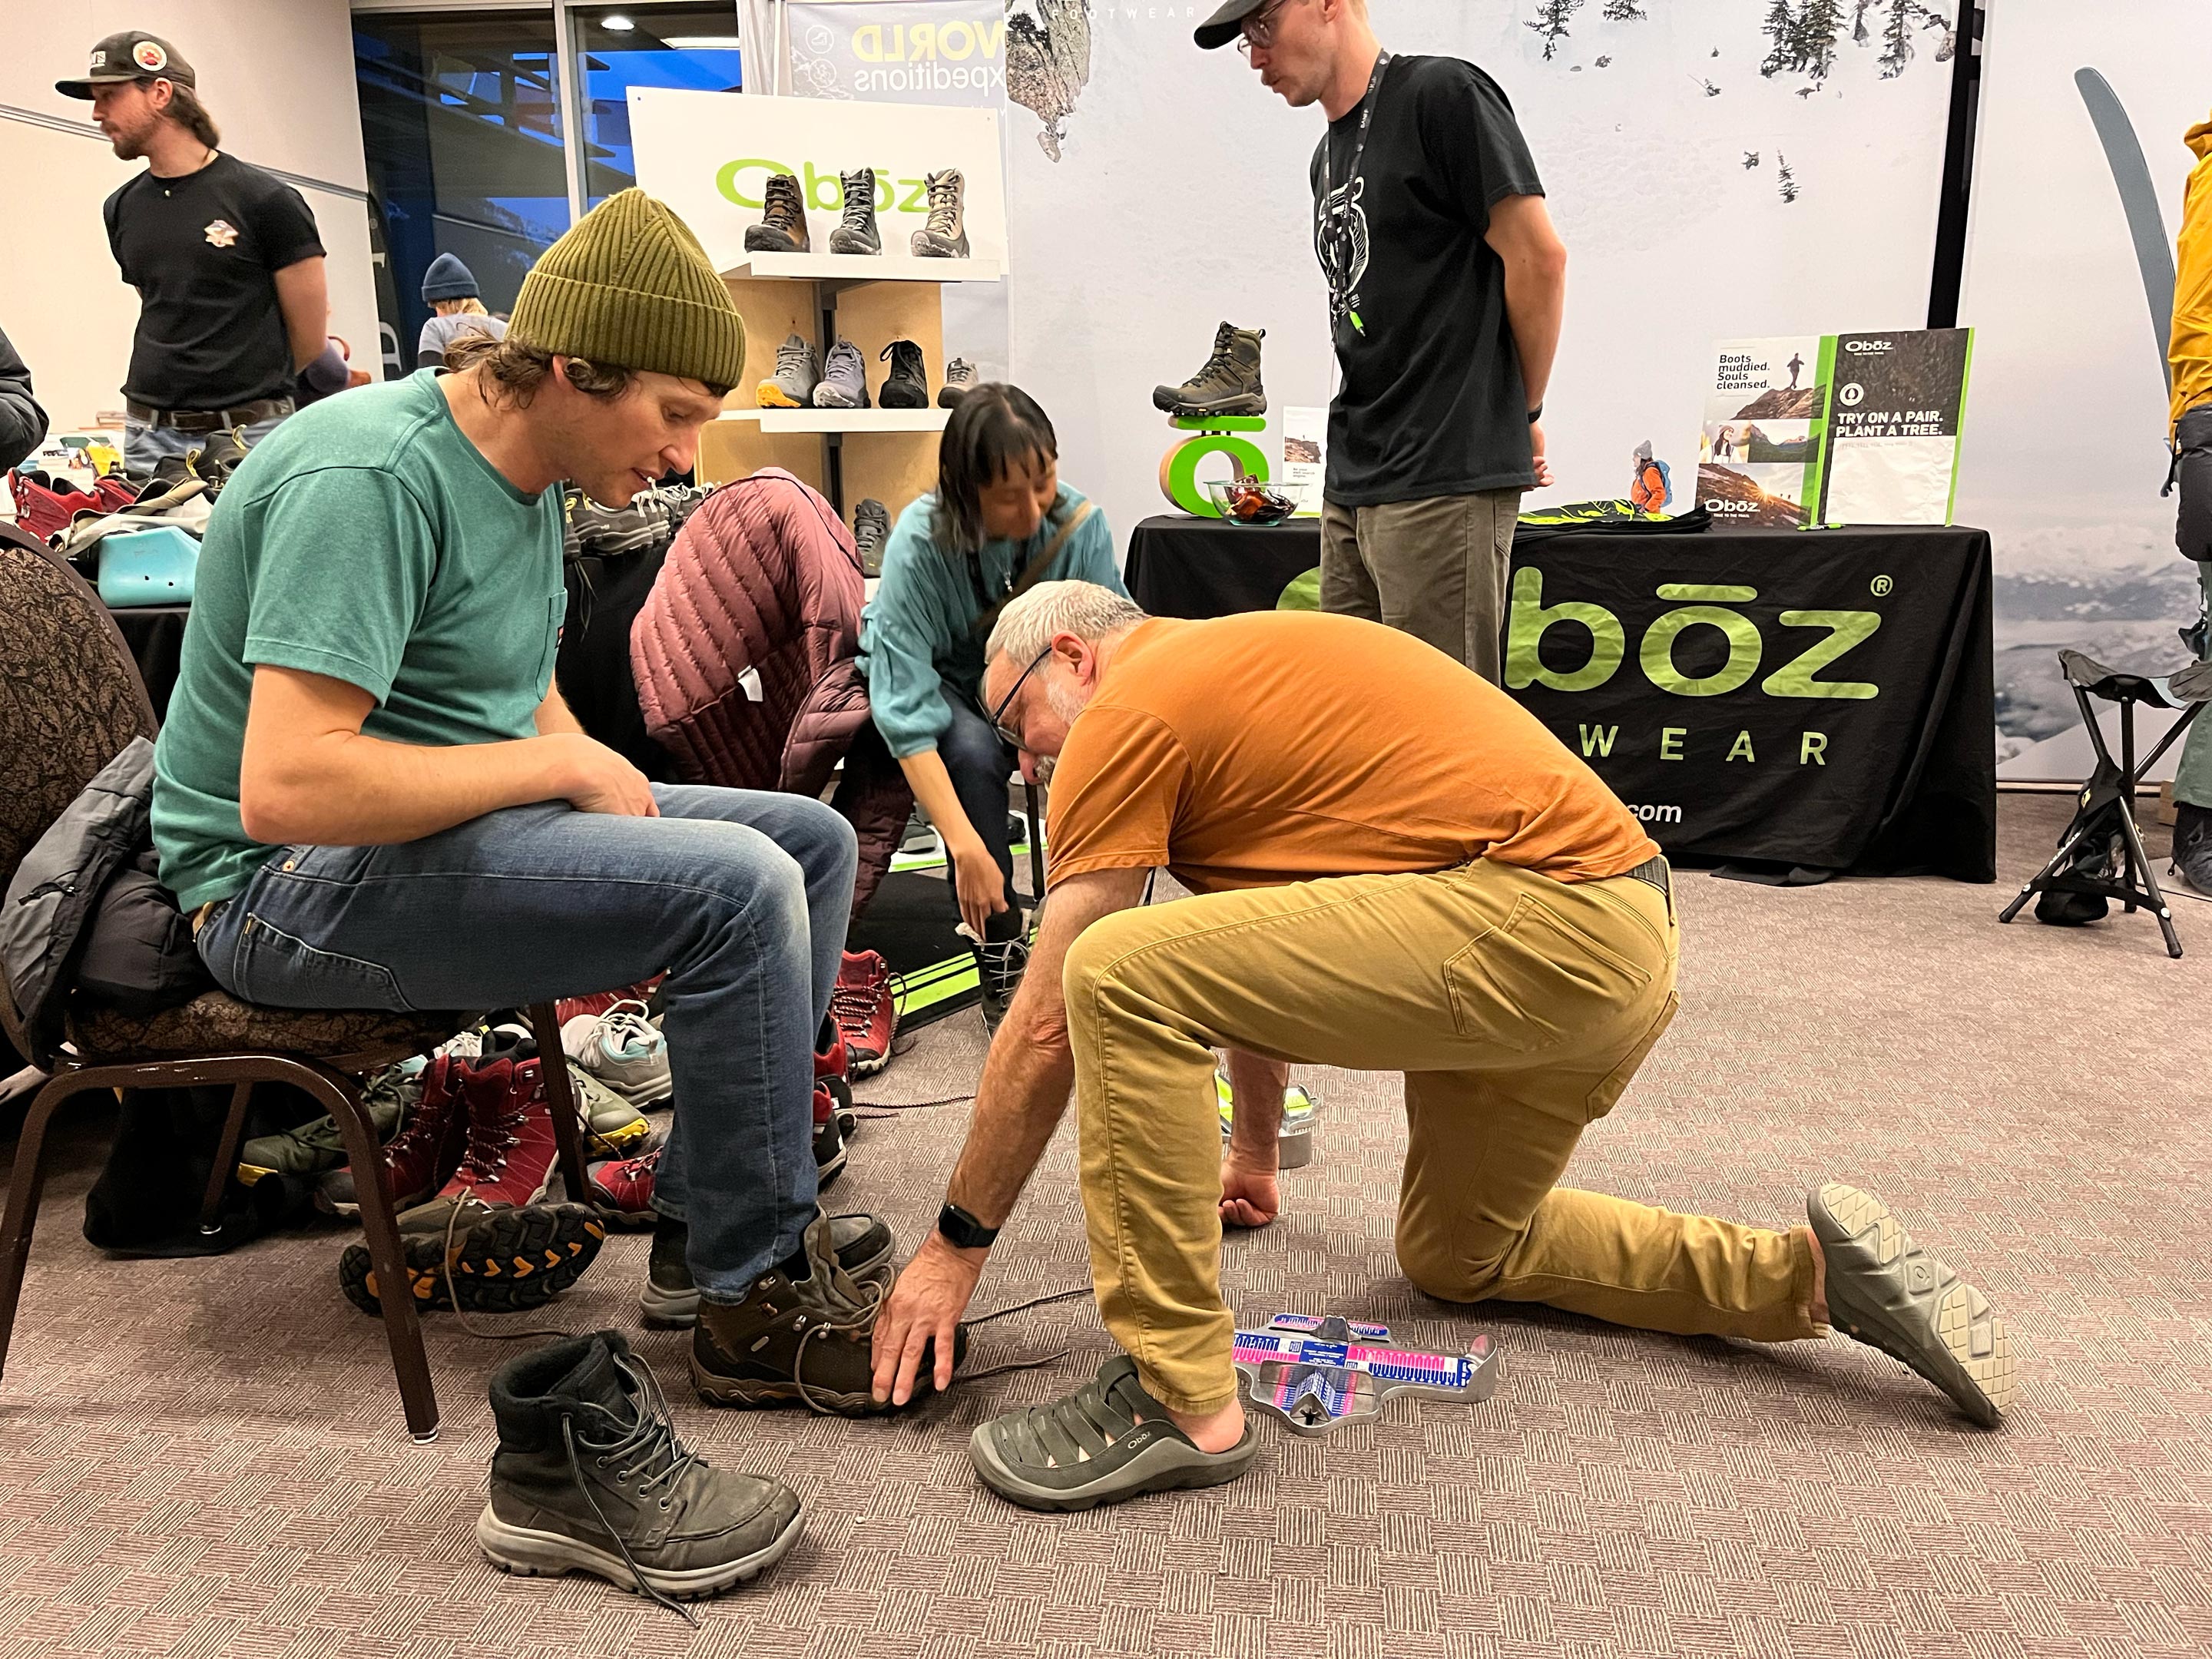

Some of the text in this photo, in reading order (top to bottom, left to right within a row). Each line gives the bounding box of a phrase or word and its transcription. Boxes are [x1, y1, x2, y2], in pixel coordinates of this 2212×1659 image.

[1051, 7, 1195, 20] FOOTWEAR
[1720, 354, 1751, 363] Boots
[1718, 362, 1770, 372] muddied.
[1717, 372, 1748, 381] Souls
[1717, 379, 1770, 389] cleansed.
[1837, 410, 1943, 424] TRY ON A PAIR.
[1836, 424, 1942, 437] PLANT A TREE.
[1579, 724, 1828, 766] WEAR
